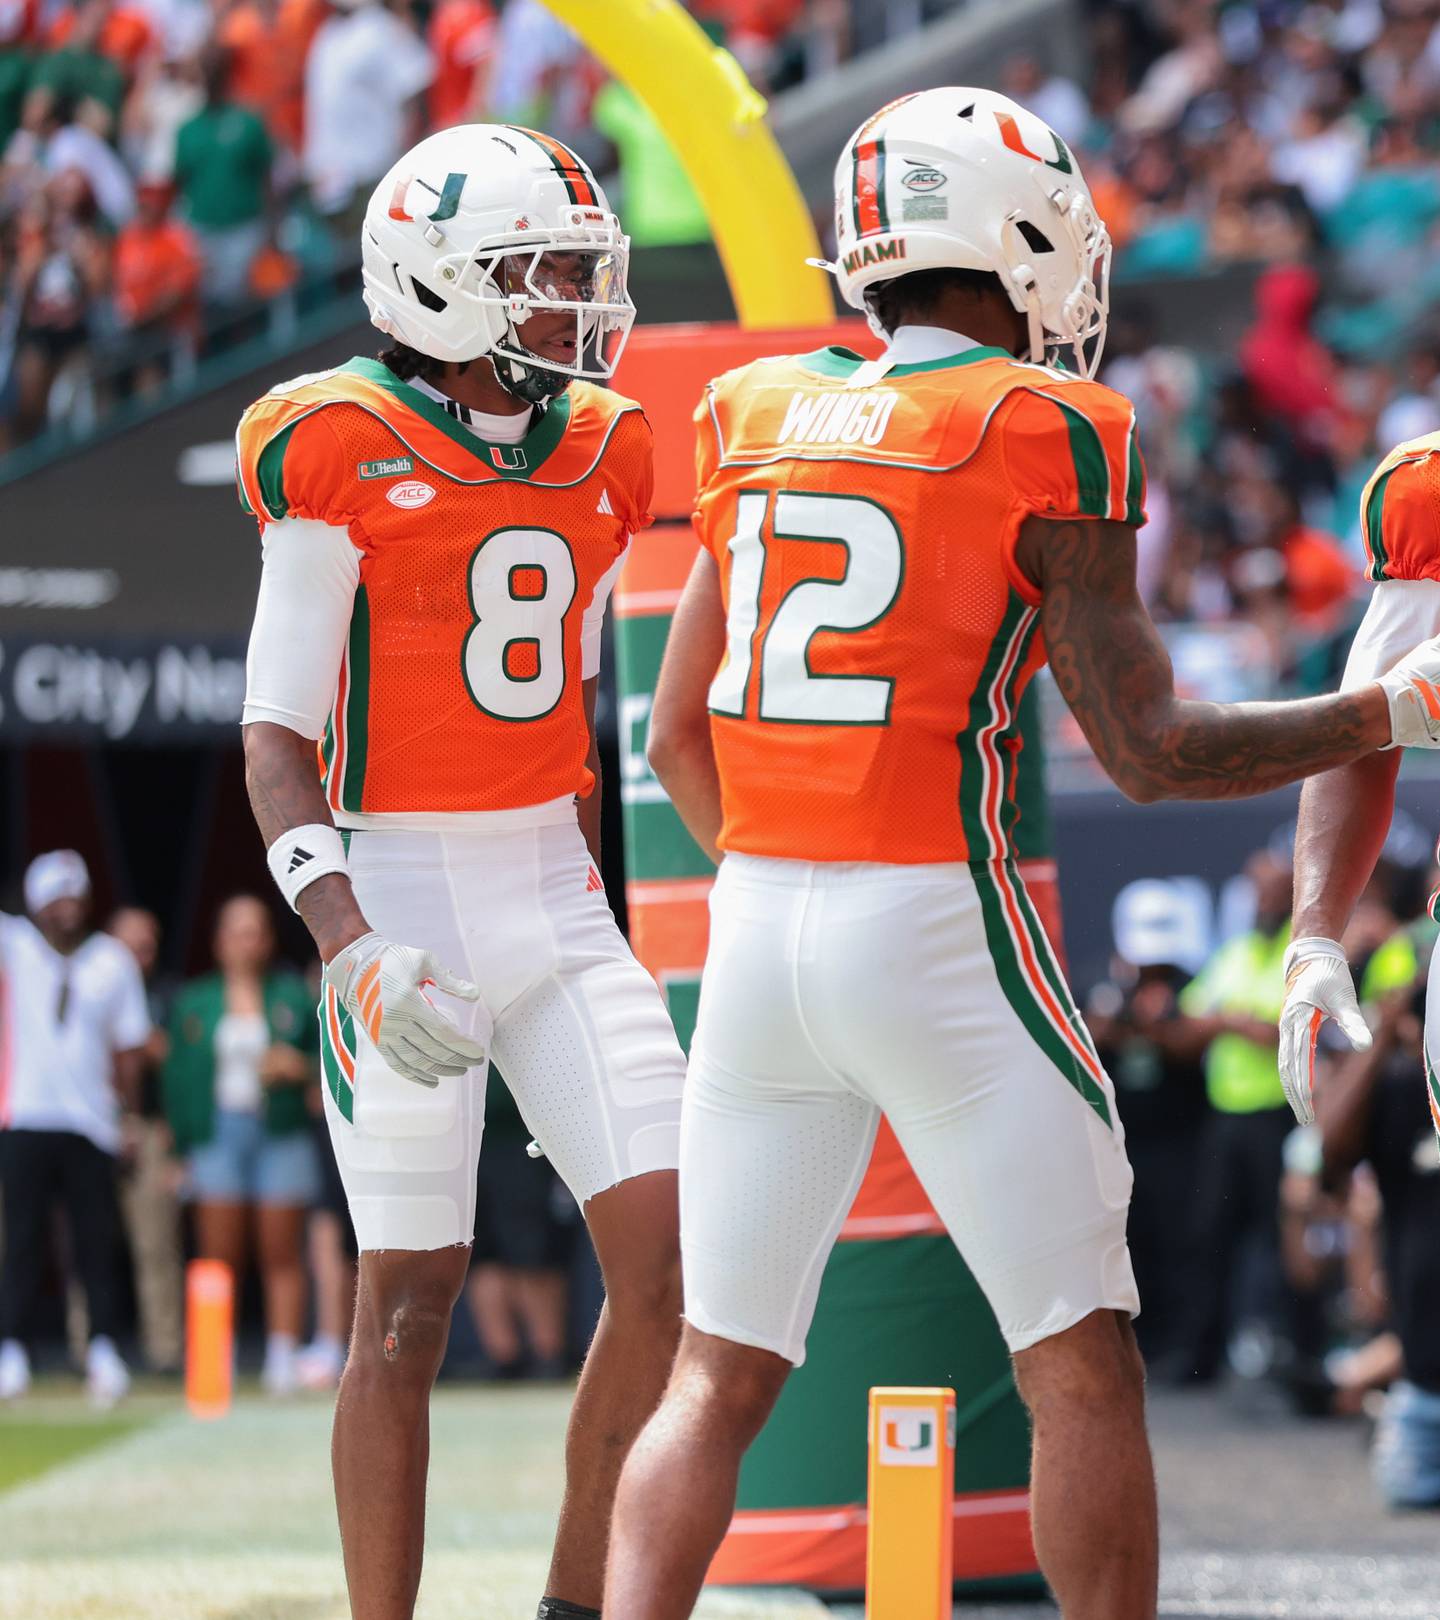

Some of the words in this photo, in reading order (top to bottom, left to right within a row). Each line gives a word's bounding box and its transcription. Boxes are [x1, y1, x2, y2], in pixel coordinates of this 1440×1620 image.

[908, 173, 940, 184] ACC
[842, 238, 907, 276] MIAMI
[776, 391, 899, 446] WINGO
[489, 447, 528, 470] U
[395, 487, 426, 499] ACC
[460, 525, 578, 723] 8
[706, 488, 907, 727] 12
[886, 1421, 932, 1453] U
